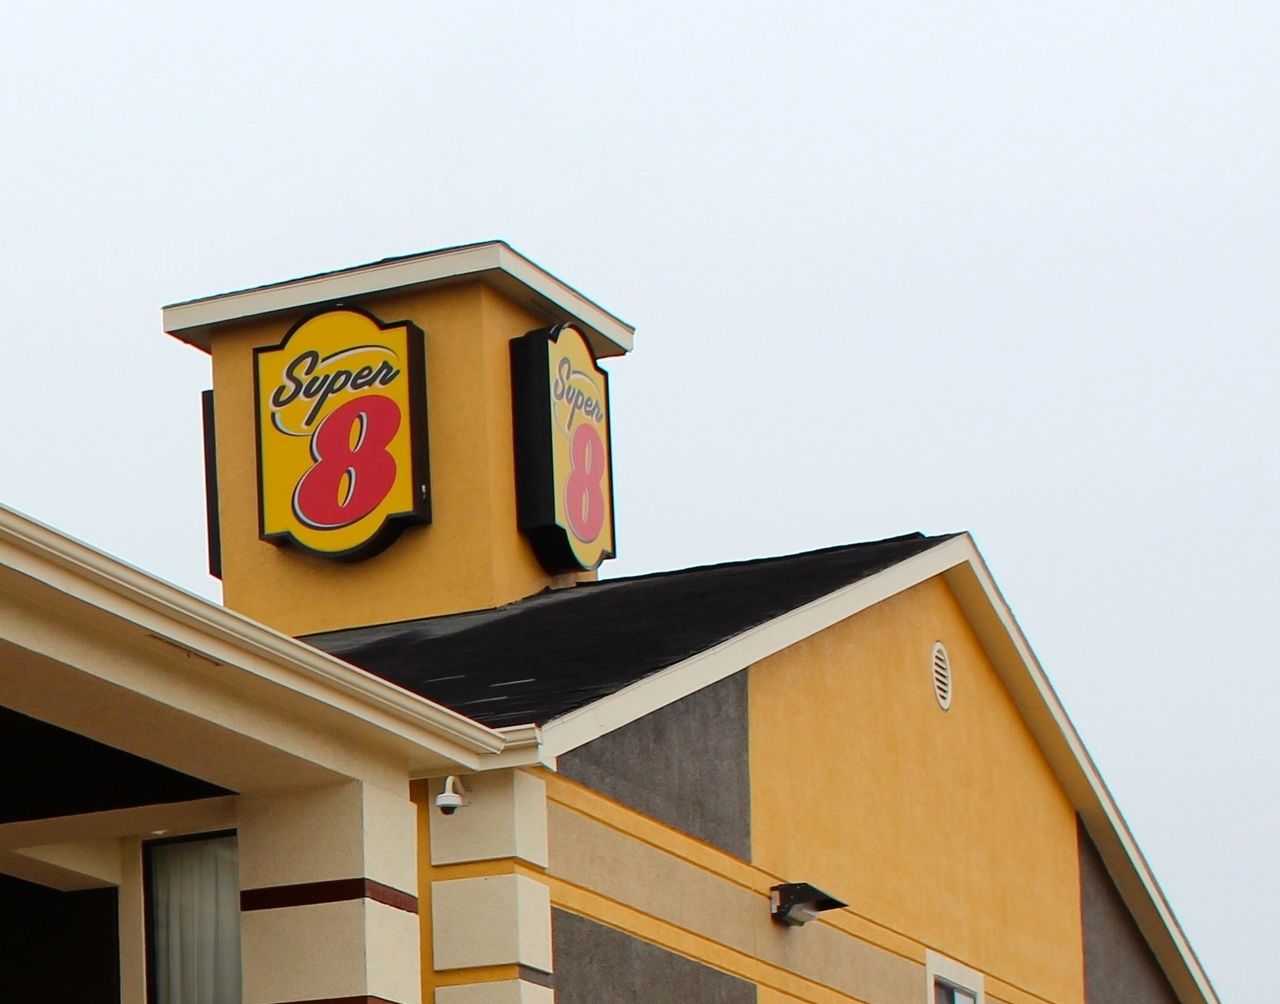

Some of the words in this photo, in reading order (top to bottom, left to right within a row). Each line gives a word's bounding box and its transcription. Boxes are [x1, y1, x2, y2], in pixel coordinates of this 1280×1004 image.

[271, 349, 401, 427] Super
[554, 357, 604, 430] Super
[292, 394, 402, 531] 8
[564, 422, 605, 543] 8
